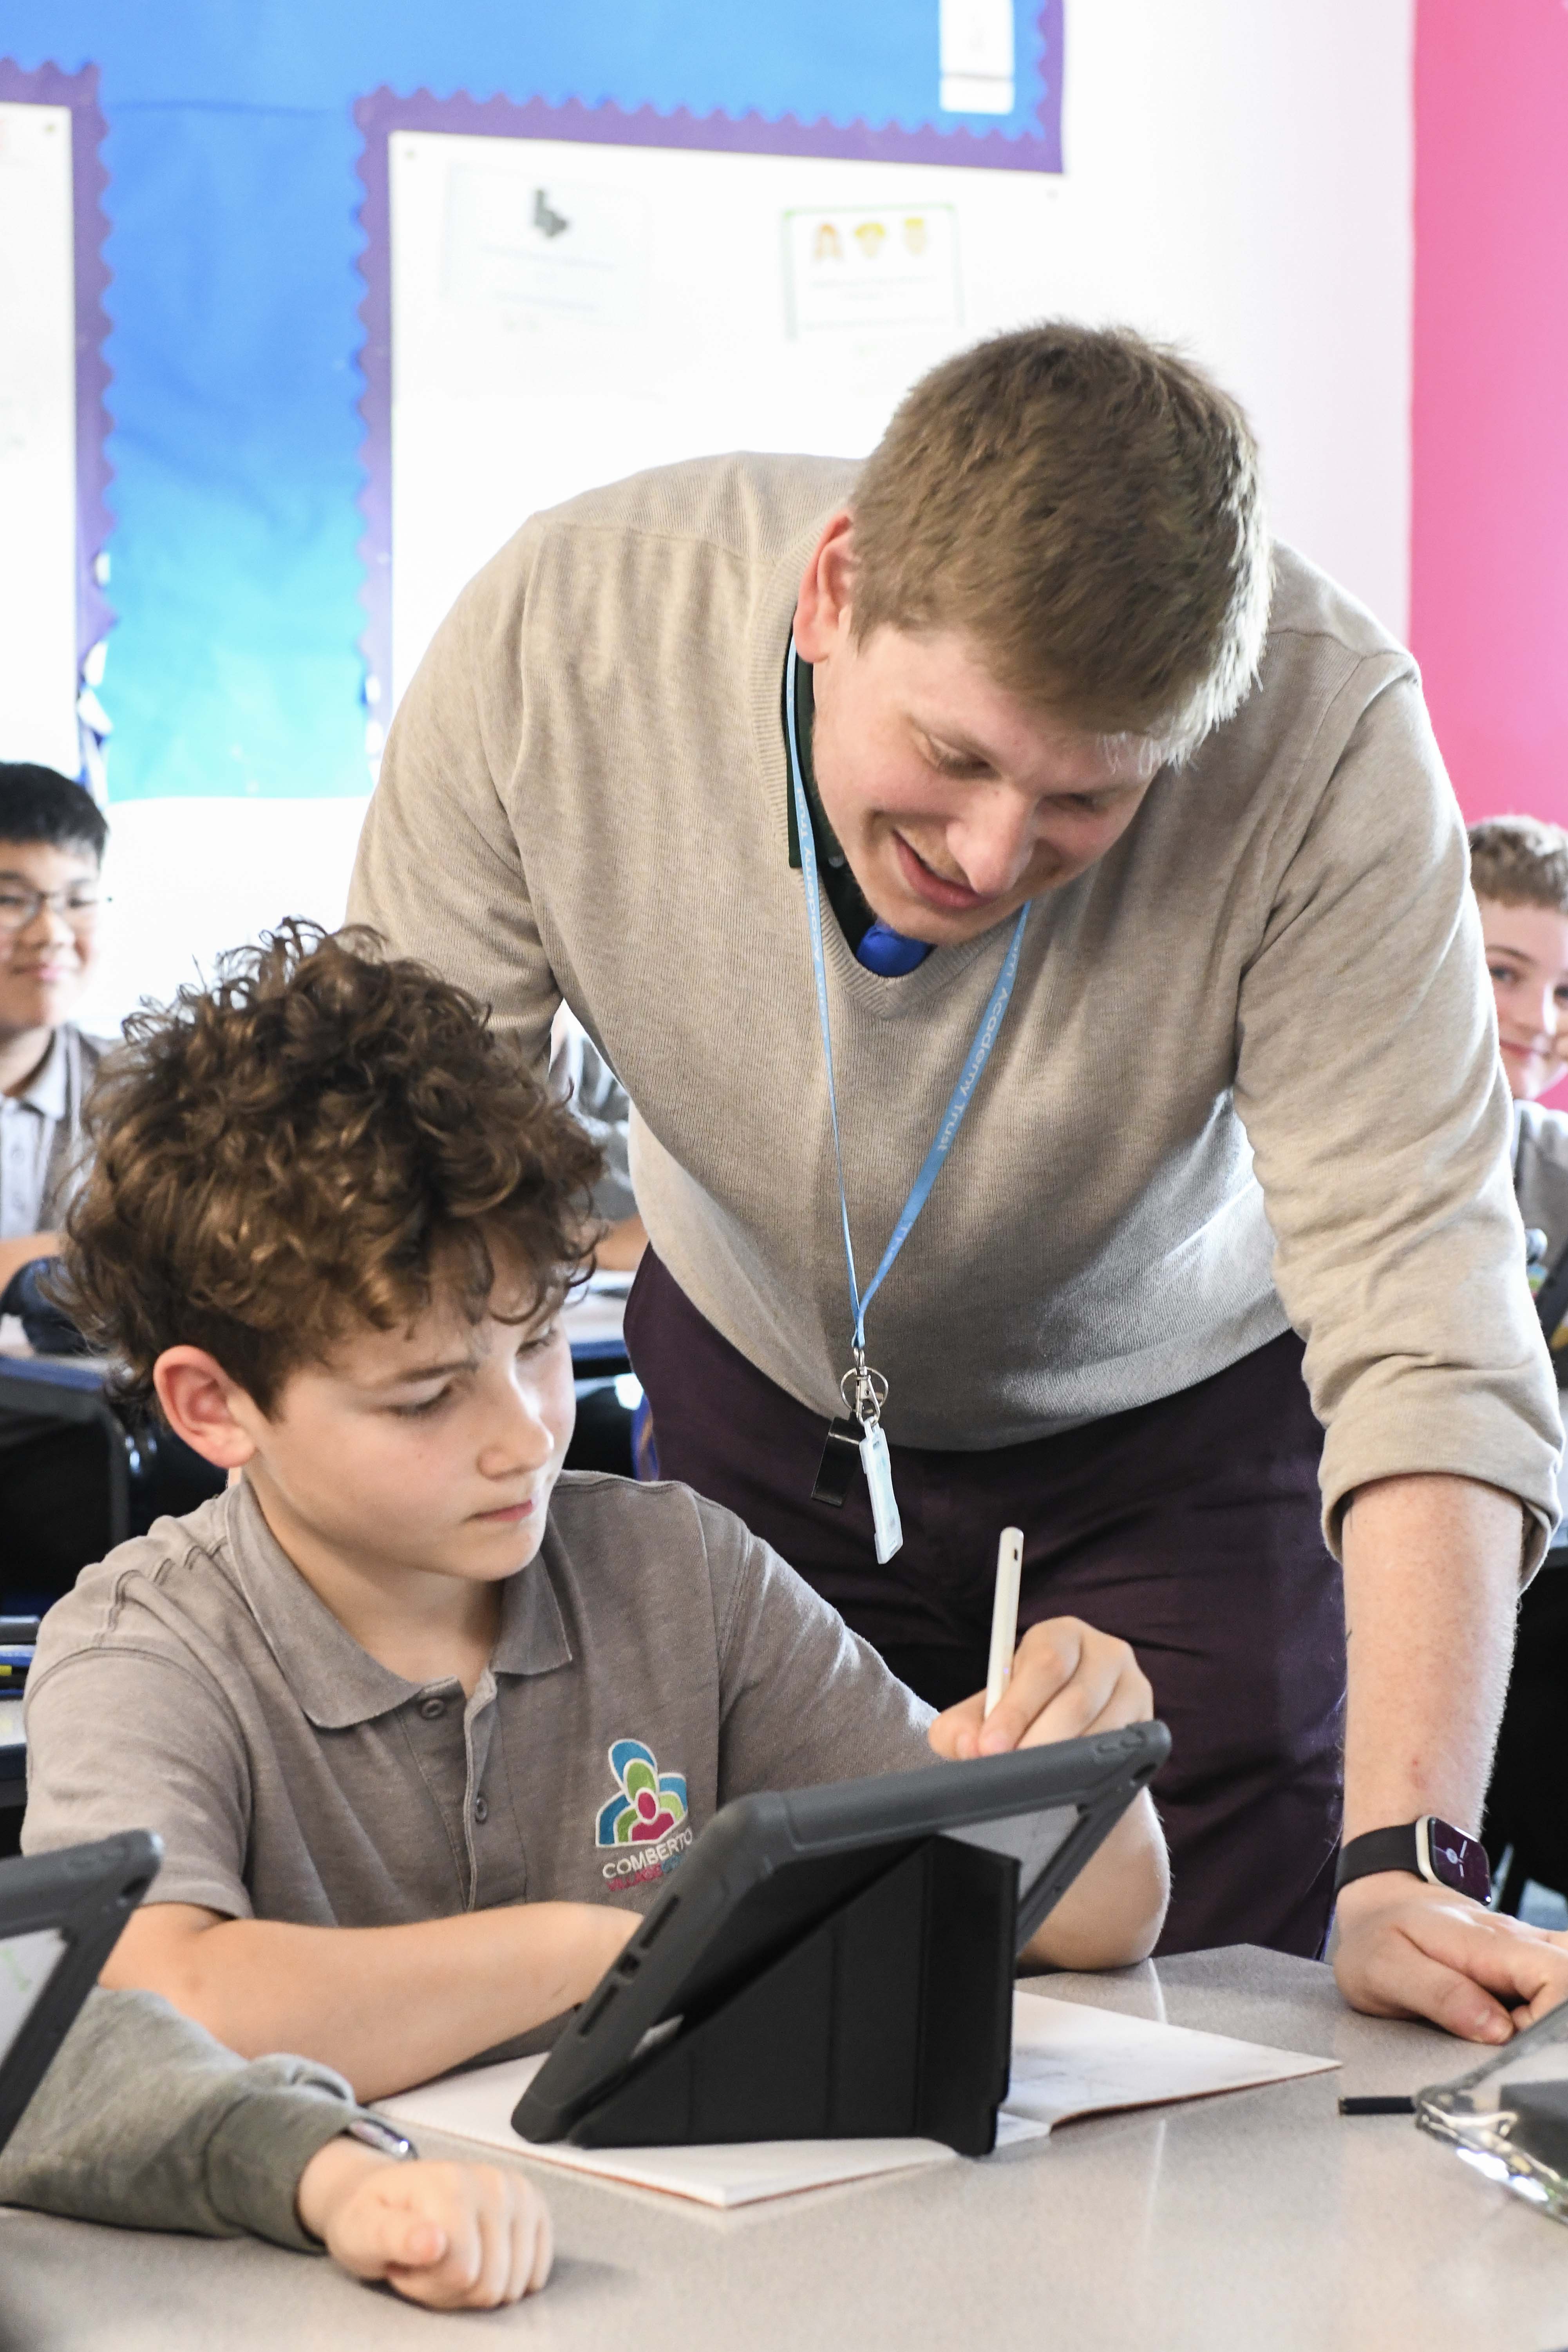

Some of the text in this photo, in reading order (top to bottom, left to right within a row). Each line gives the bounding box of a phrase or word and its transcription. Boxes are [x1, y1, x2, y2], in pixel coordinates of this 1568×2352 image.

[797, 787, 808, 840] Trust
[804, 845, 820, 962] Academy
[960, 987, 1008, 1097] Academy
[937, 1102, 966, 1152] Trust
[602, 1827, 693, 1879] COMBERTO
